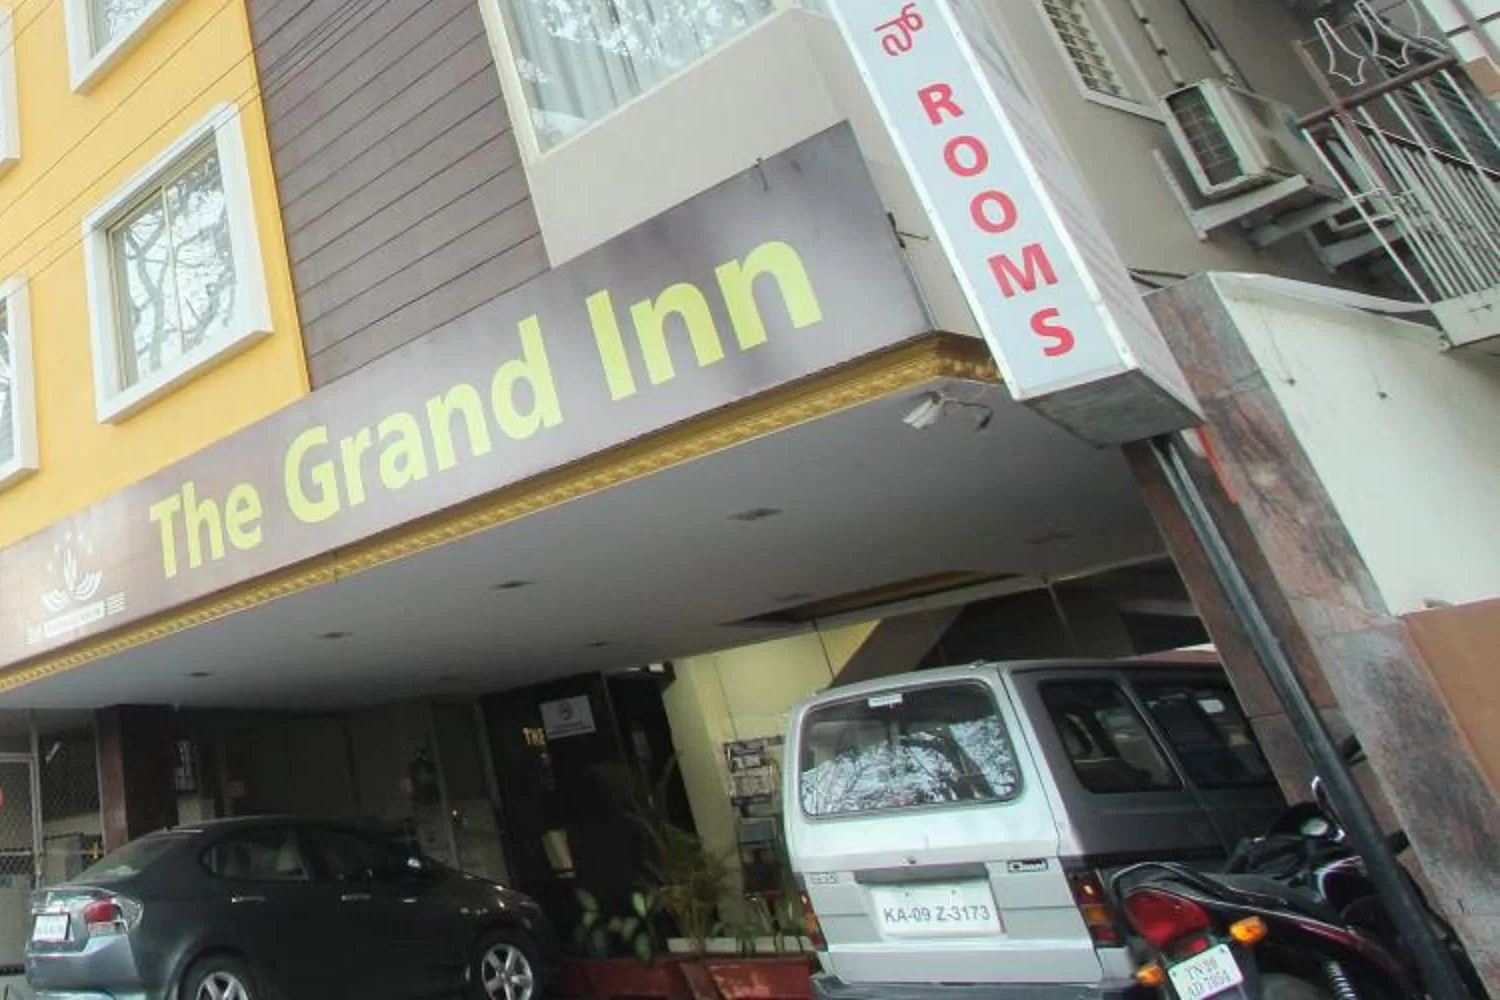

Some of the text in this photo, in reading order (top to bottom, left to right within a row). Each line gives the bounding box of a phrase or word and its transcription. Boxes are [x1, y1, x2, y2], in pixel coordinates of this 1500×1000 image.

[917, 83, 1075, 357] ROOMS
[149, 240, 822, 580] The Grand Inn
[884, 905, 990, 922] KA-09 Z-3173
